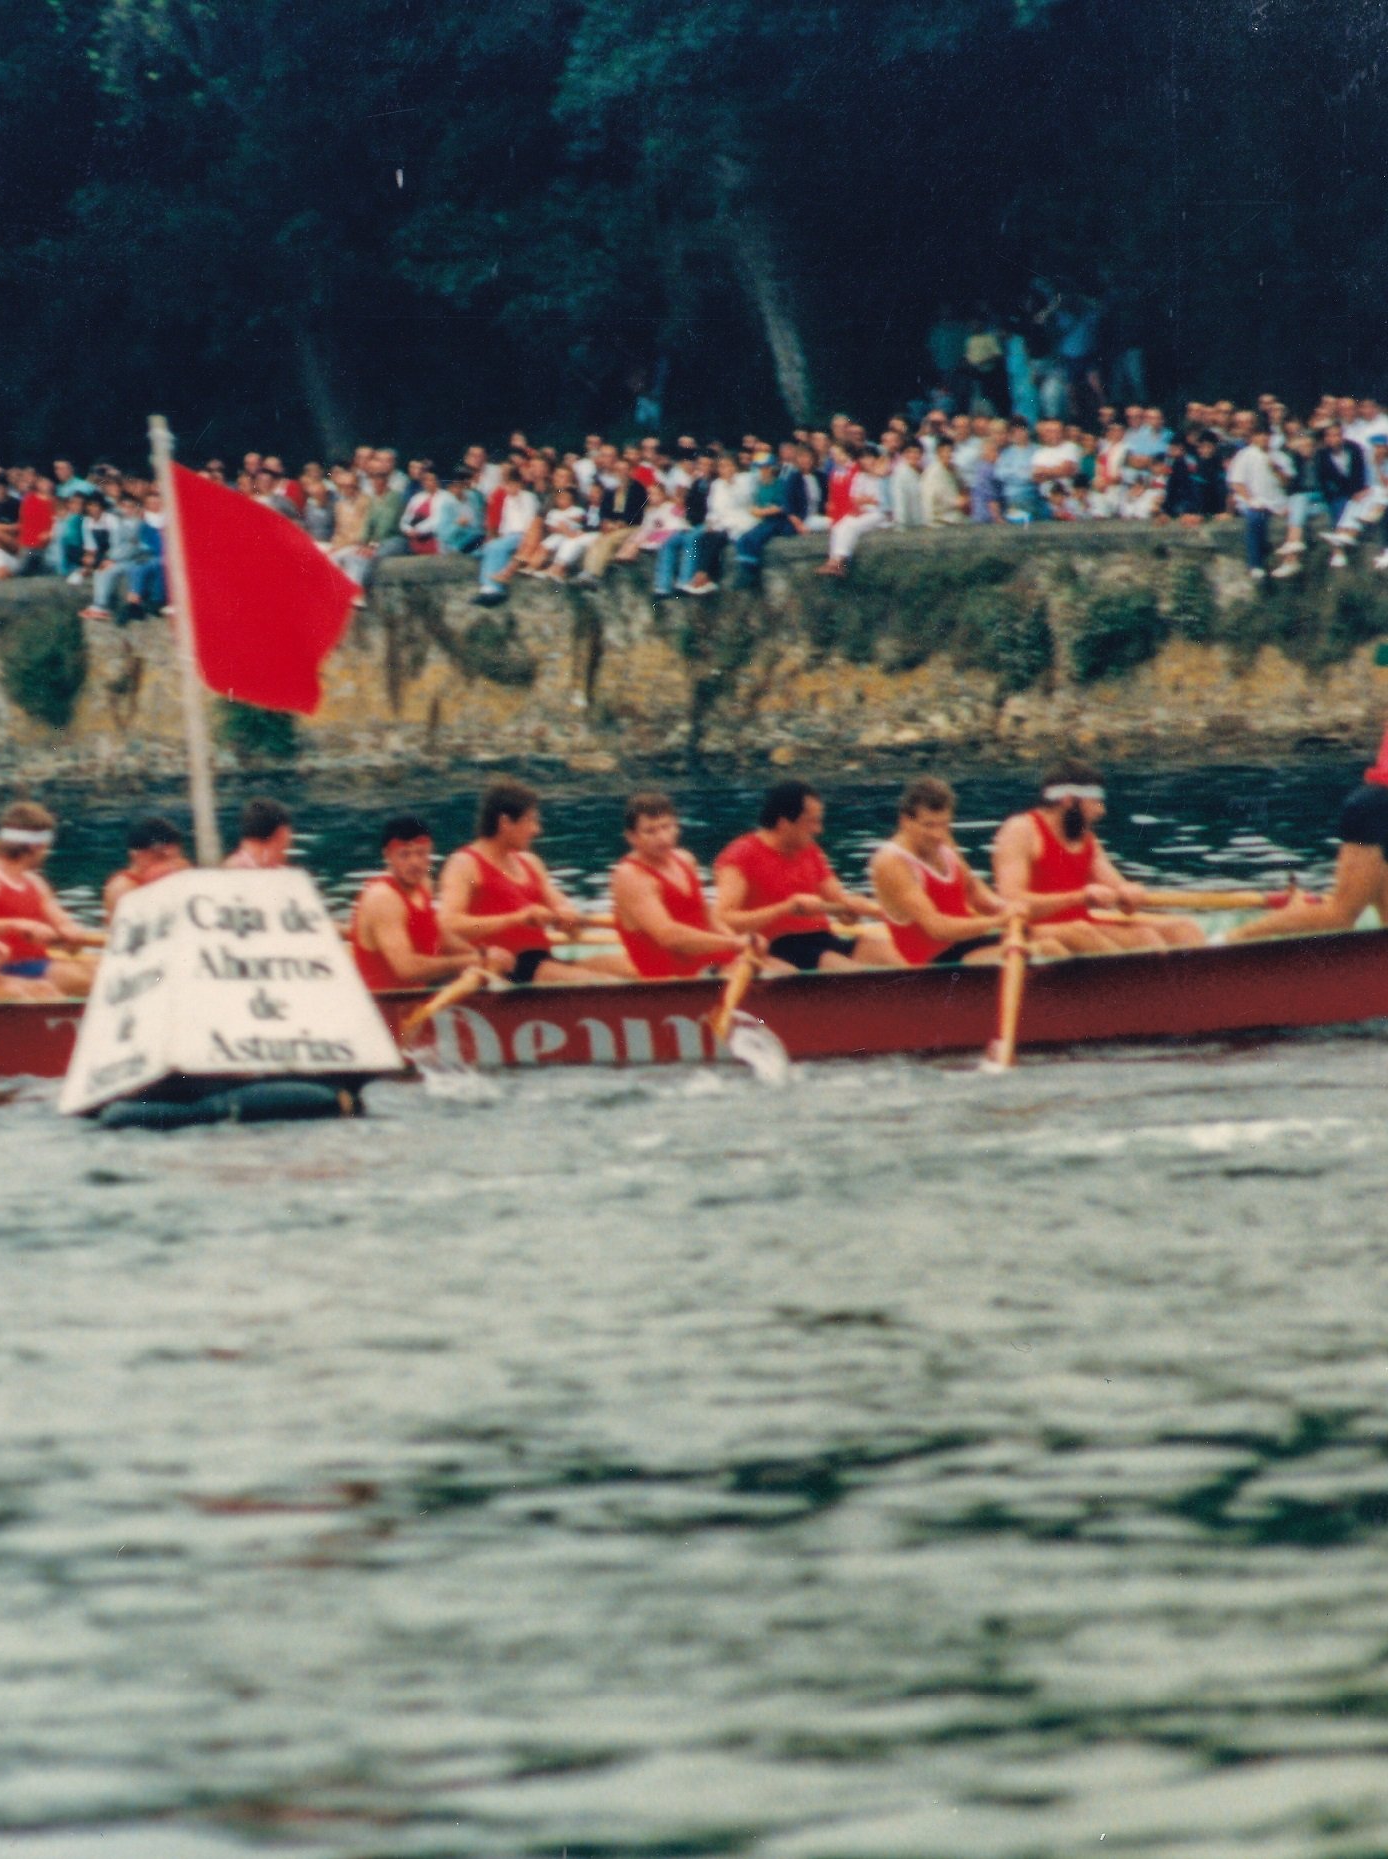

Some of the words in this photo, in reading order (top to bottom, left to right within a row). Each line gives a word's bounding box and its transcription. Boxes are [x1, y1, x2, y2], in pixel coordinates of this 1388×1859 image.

[186, 894, 266, 940] Caja
[281, 899, 321, 933] de
[195, 946, 333, 981] Ahorros
[249, 989, 287, 1021] de
[208, 1030, 355, 1063] Asturias
